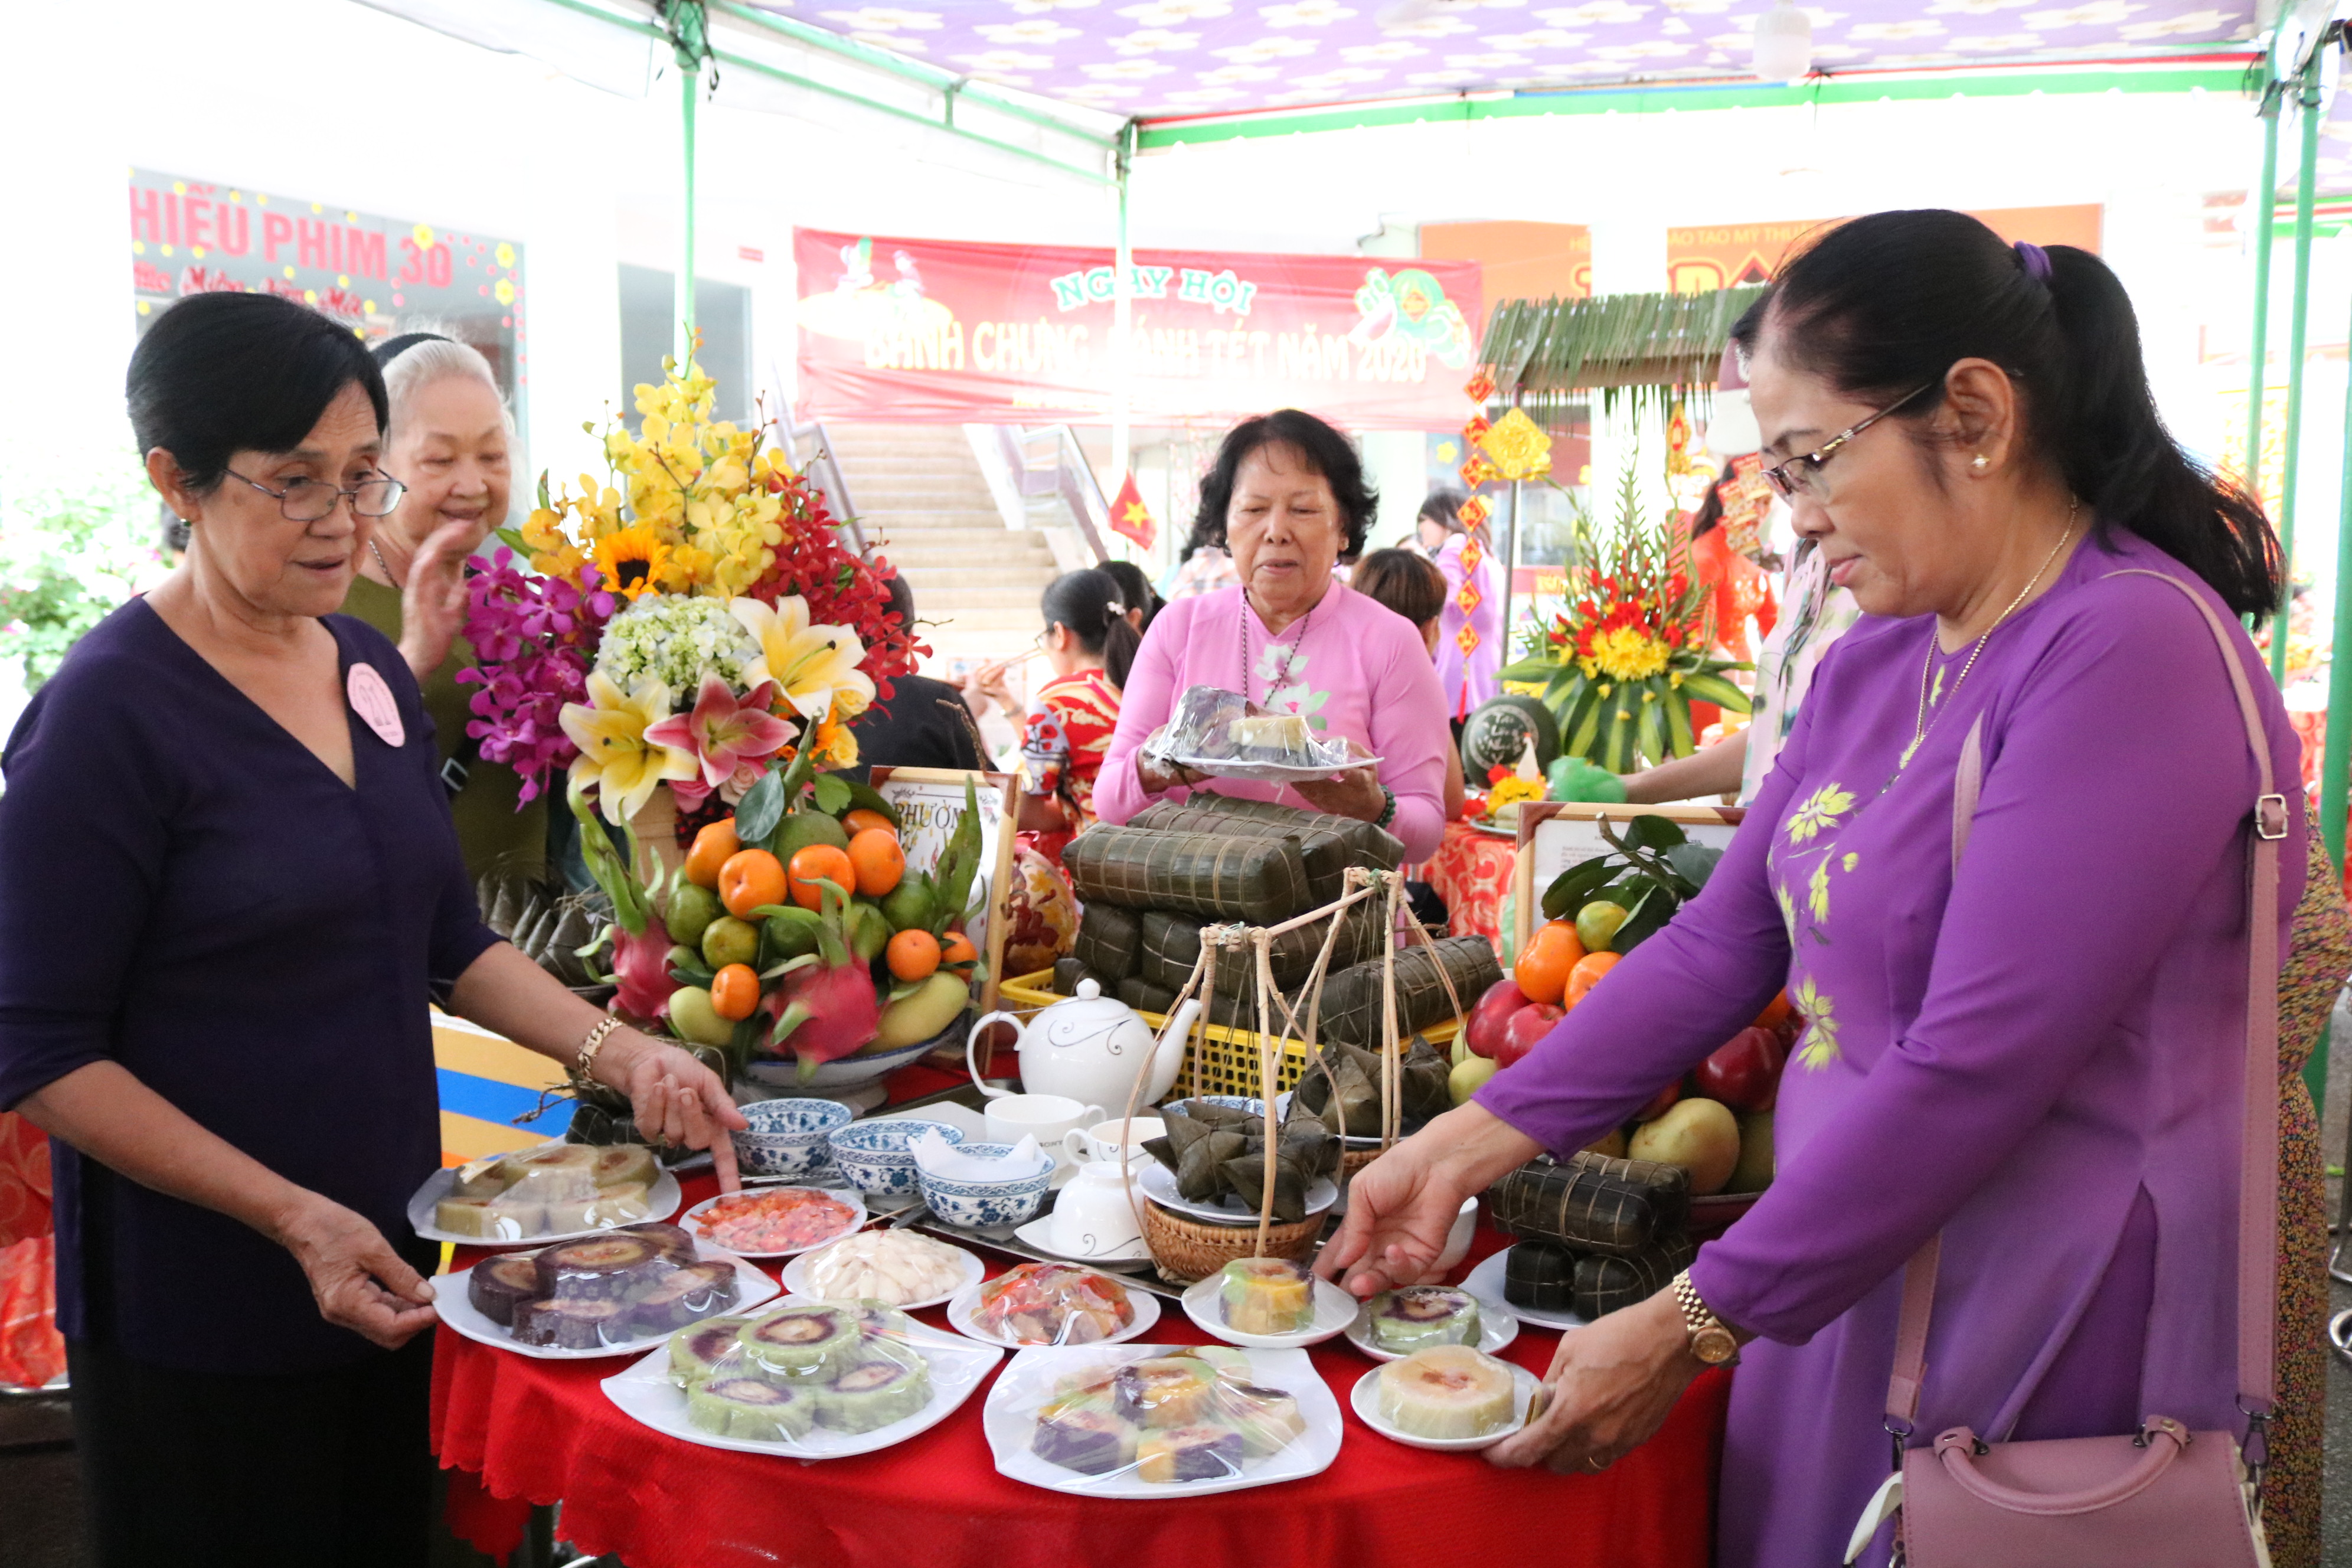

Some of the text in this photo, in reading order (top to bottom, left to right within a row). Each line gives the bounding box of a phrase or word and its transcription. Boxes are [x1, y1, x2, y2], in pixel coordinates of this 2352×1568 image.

[262, 211, 387, 282] PHIM
[399, 236, 453, 289] 3D
[1277, 322, 1350, 381] NĂM
[1357, 335, 1427, 383] 2020
